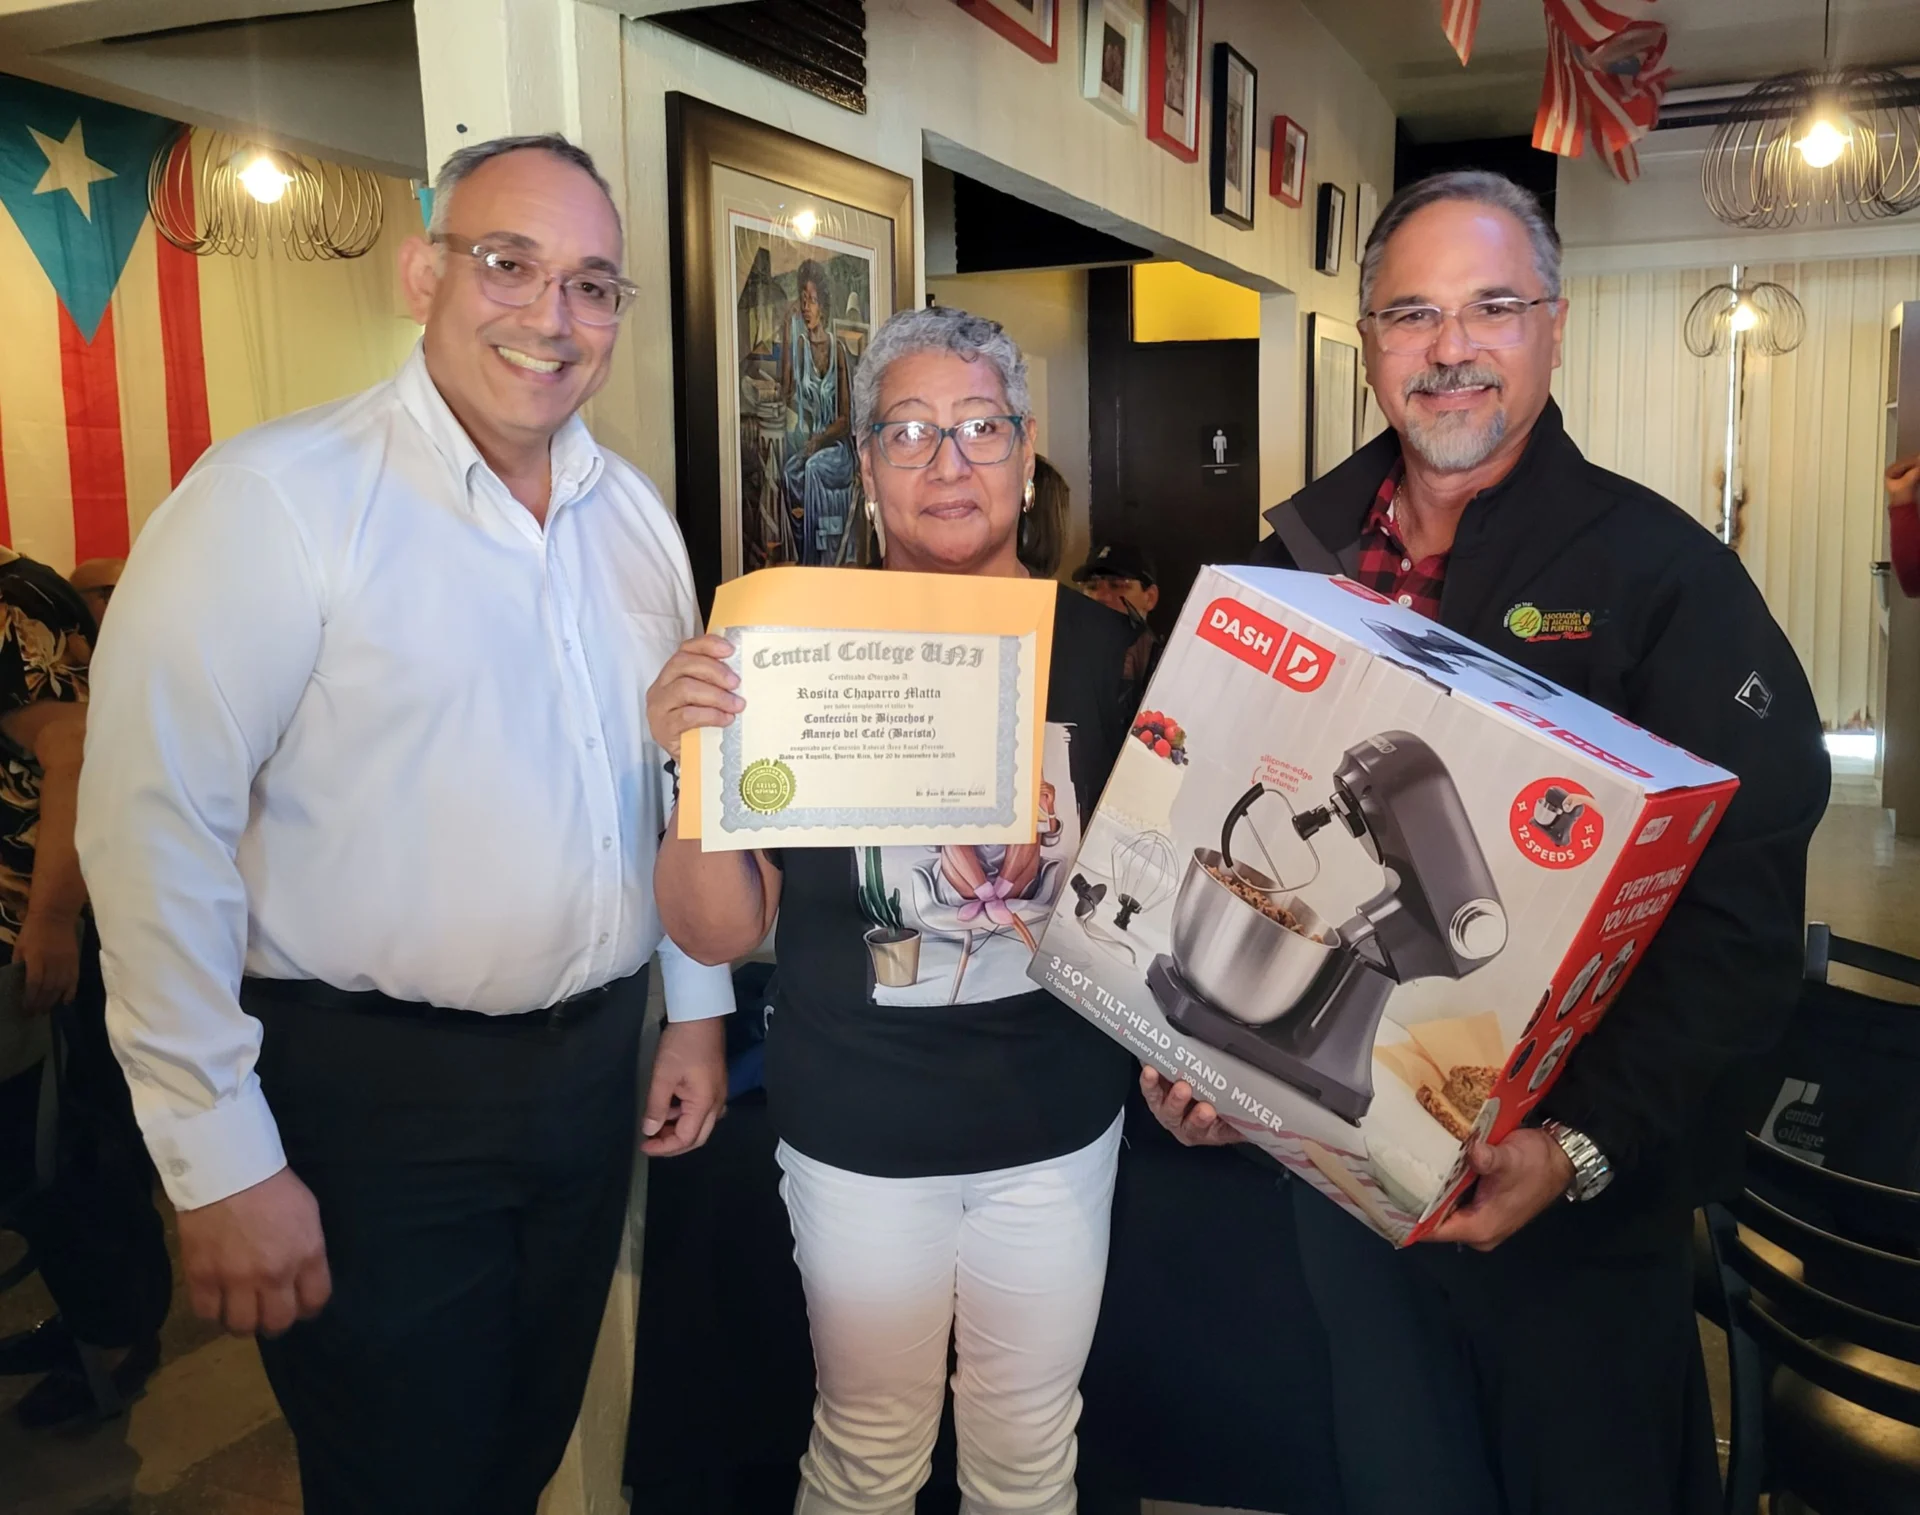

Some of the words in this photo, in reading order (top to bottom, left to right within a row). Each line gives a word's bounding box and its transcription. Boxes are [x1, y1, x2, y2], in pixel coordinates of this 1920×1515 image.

[1543, 612, 1581, 620] ASOCIACIÓN
[1210, 608, 1273, 656] DASH
[753, 642, 831, 669] Central
[838, 640, 916, 665] College
[797, 687, 839, 700] Rosita
[843, 687, 900, 701] Chaparro
[904, 687, 941, 700] Matta
[804, 711, 858, 724] Confección
[861, 713, 872, 723] de
[876, 713, 925, 725] Bizcochos
[928, 714, 934, 725] y
[800, 728, 840, 740] Manejo
[843, 728, 858, 739] del
[861, 727, 885, 739] Café
[888, 727, 936, 740] (Barista)
[1260, 754, 1313, 780] silicone-edge
[1267, 765, 1278, 775] for
[1280, 771, 1299, 784] even
[1262, 774, 1299, 793] mixtures!
[1518, 825, 1530, 840] 12
[1526, 840, 1575, 862] SPEEDS
[1613, 864, 1686, 905] EVERYTHING
[1599, 907, 1630, 935] YOU
[1045, 971, 1053, 982] 12
[1052, 978, 1077, 1000] Speeds
[1081, 997, 1100, 1018] Tilting
[1101, 1013, 1120, 1031] Head
[1123, 1028, 1154, 1057] Planetary
[1154, 1051, 1178, 1075] Mixing
[1181, 1072, 1196, 1087] 300
[1197, 1082, 1217, 1102] Watts
[1050, 956, 1093, 992] 3.5QT
[1095, 986, 1171, 1050] TILT-HEAD
[1174, 1046, 1228, 1091] STAND
[1231, 1087, 1283, 1132] MIXER
